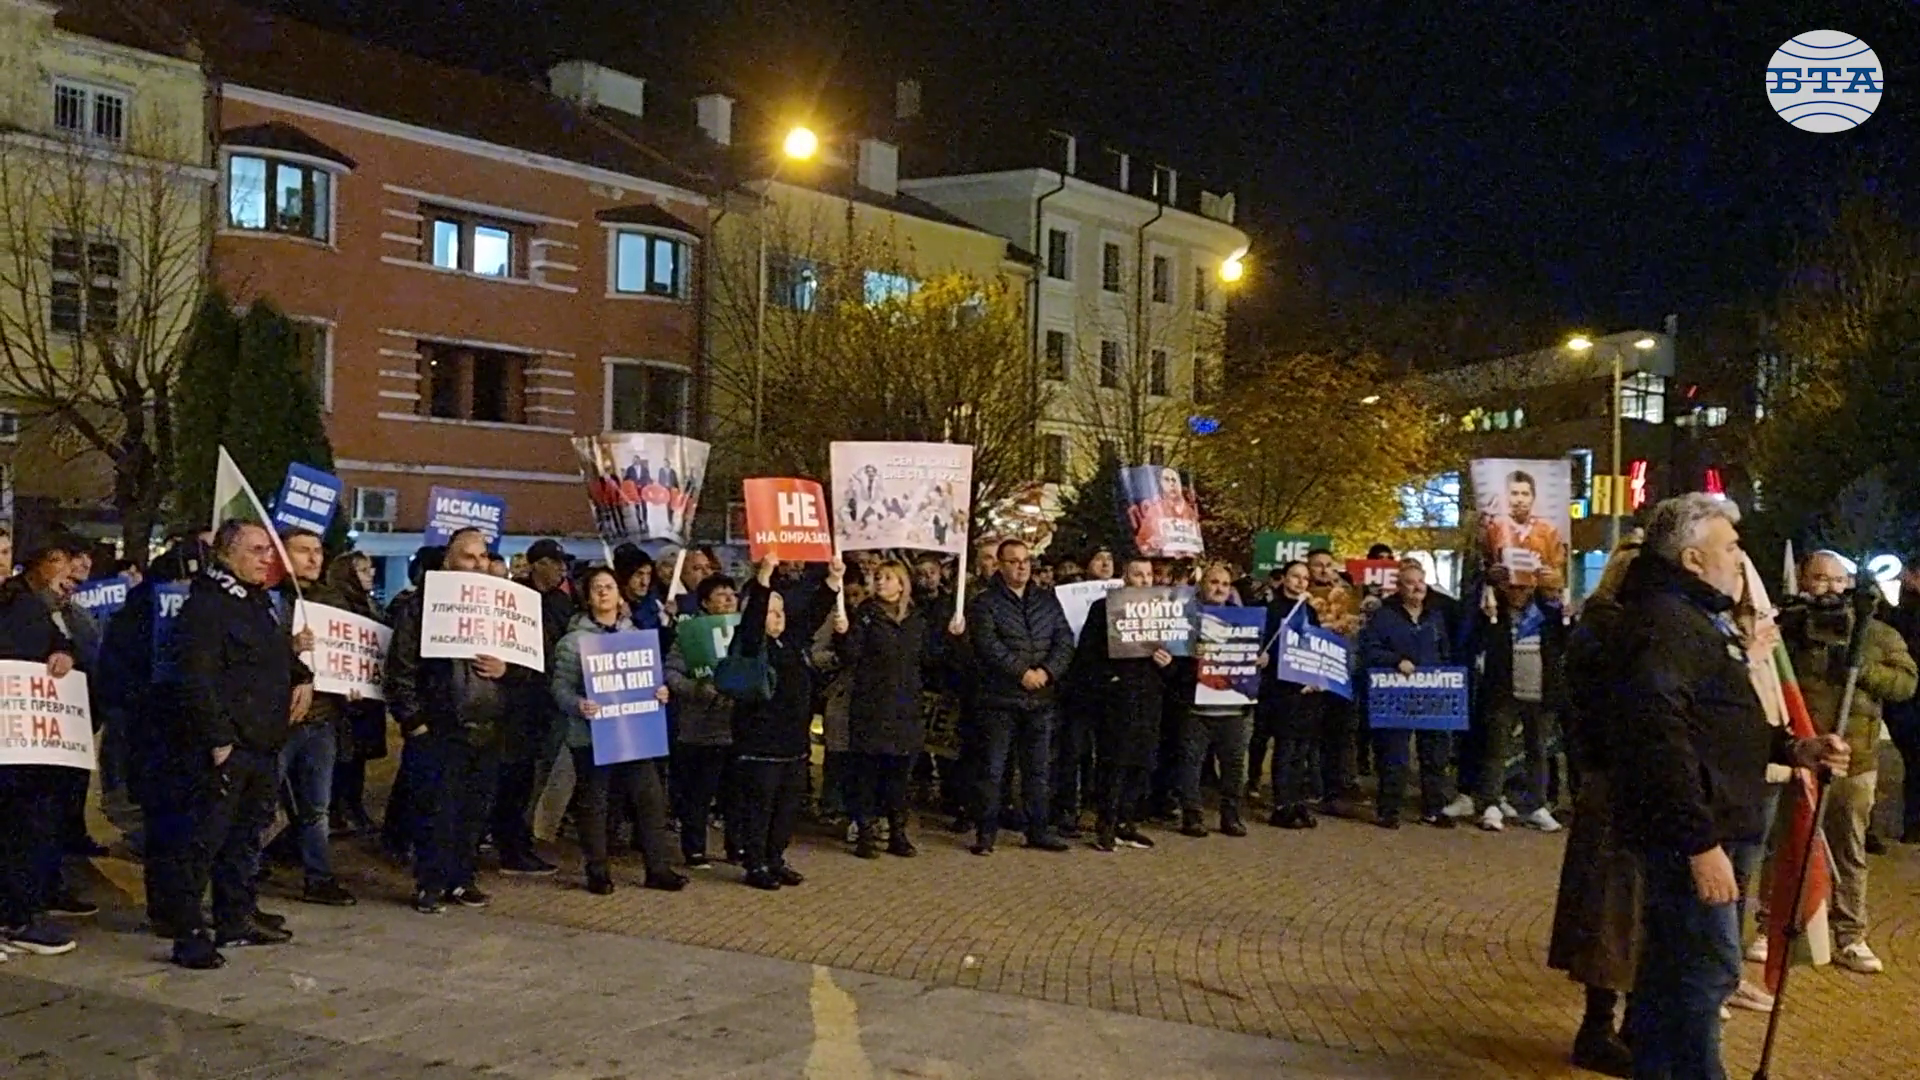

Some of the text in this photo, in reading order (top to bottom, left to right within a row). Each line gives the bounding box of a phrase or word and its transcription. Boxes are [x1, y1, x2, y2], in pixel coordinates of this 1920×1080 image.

[436, 496, 501, 522] ИСКАМЕ
[778, 491, 820, 527] НЕ
[756, 530, 777, 544] НА
[1275, 540, 1311, 563] НЕ
[1364, 567, 1399, 589] НЕ
[432, 602, 491, 616] УЛИЧНИТЕ
[461, 584, 517, 611] НЕ НА
[1125, 598, 1184, 618] КОЙТО
[327, 619, 381, 649] НЕ НА
[458, 617, 518, 642] НЕ НА
[1286, 629, 1348, 665] ИКАМЕ
[326, 651, 353, 674] НЕ
[358, 657, 382, 681] НА
[586, 648, 654, 673] ТУК СМЕ!
[29, 675, 59, 701] НА
[591, 673, 626, 694] ИМА
[32, 715, 62, 740] НА
[31, 738, 39, 748] И
